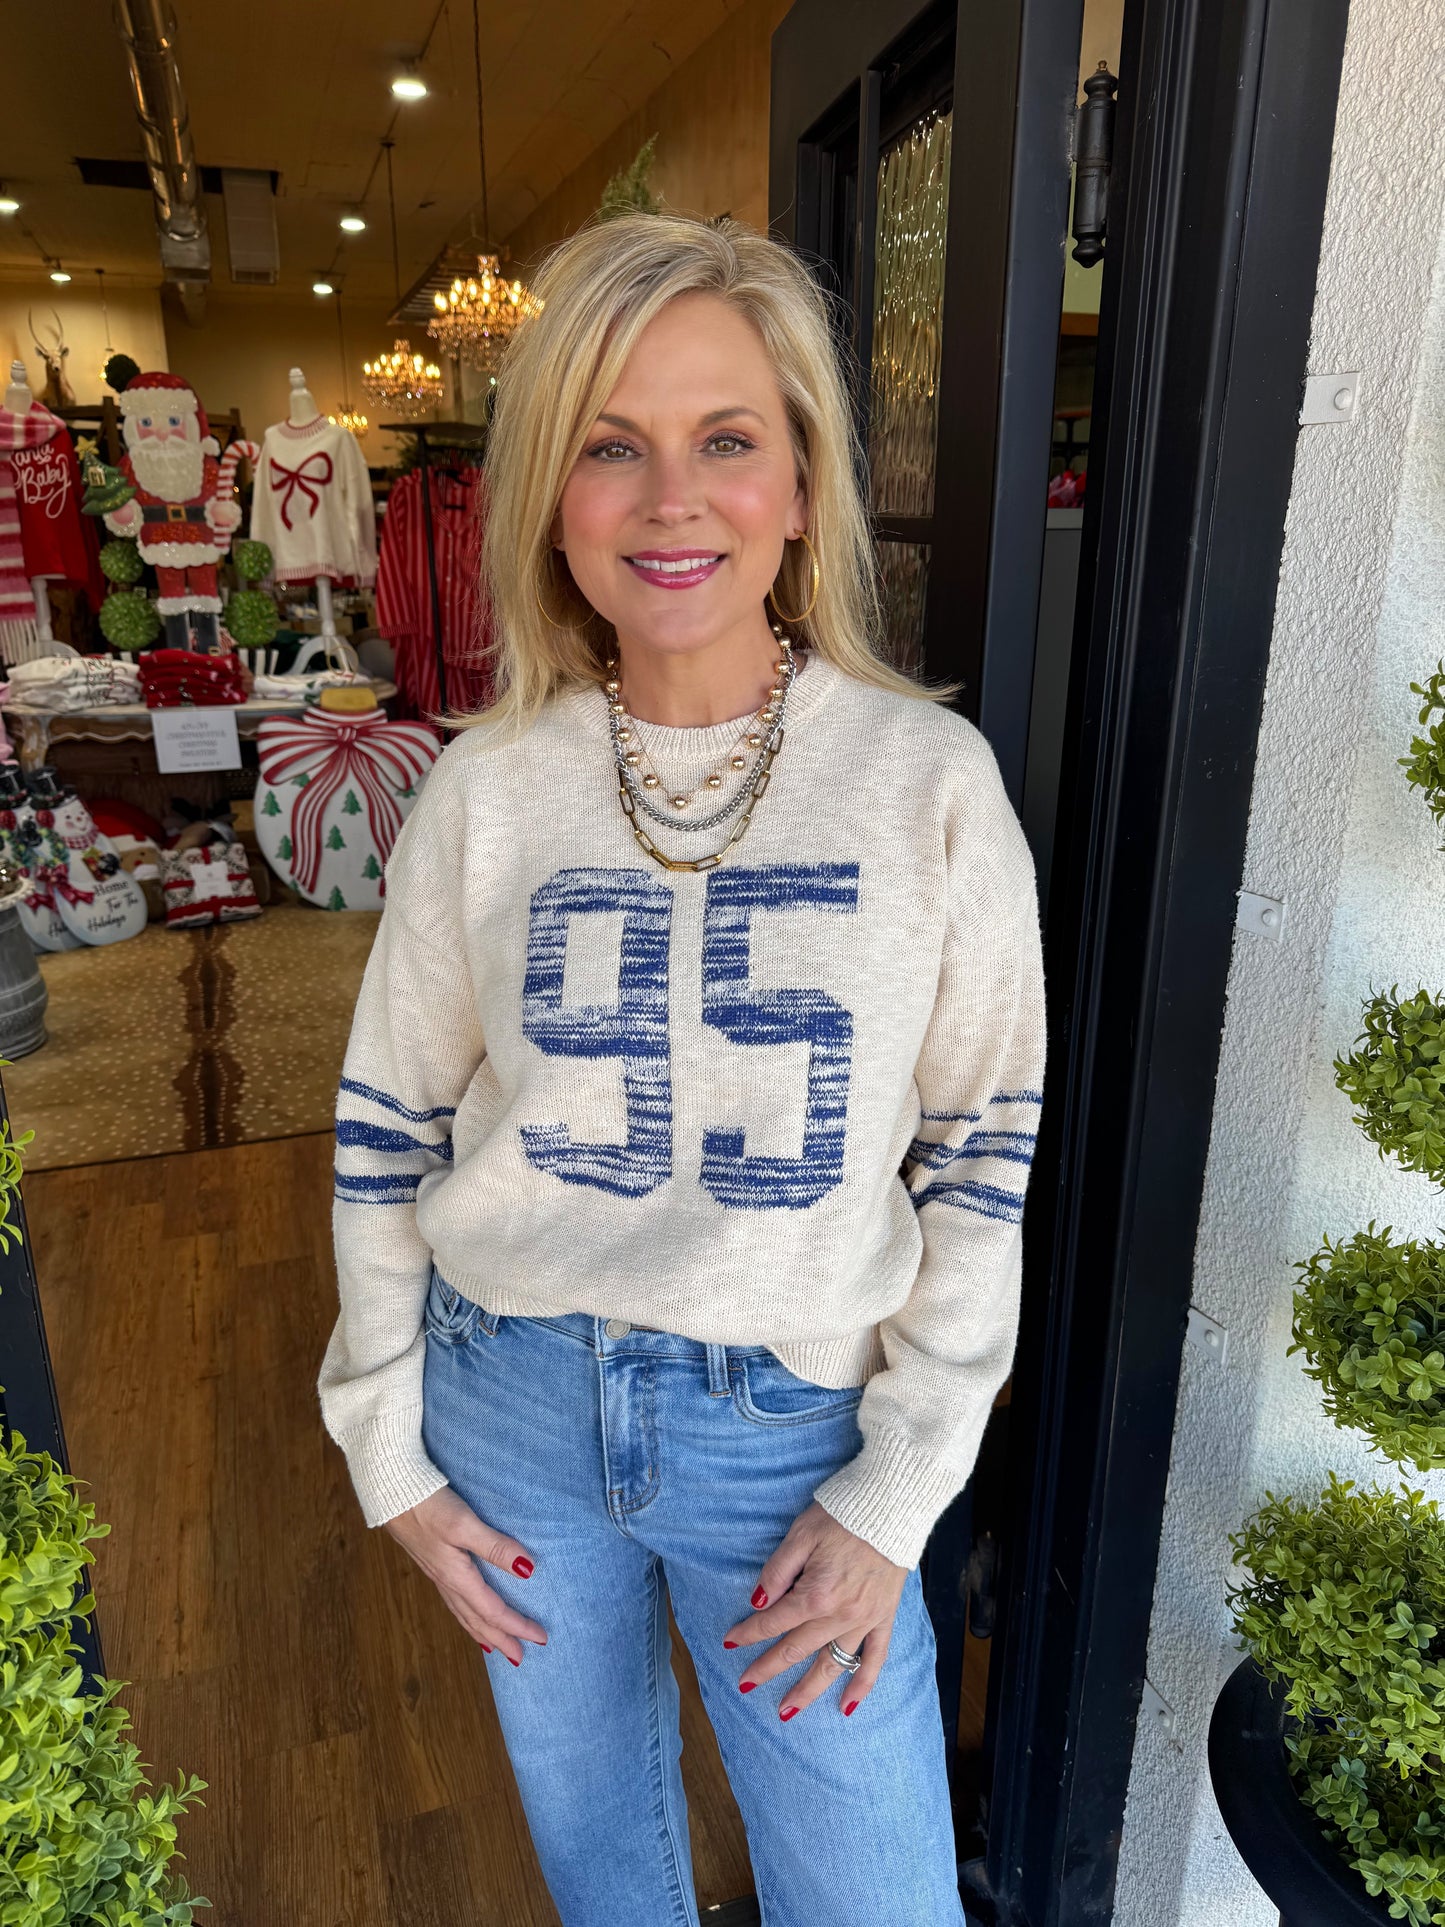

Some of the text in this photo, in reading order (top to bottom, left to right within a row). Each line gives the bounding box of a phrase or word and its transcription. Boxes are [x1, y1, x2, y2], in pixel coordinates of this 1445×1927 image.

[21, 453, 72, 519] Baby
[93, 881, 128, 896] Home
[520, 862, 859, 1210] 95
